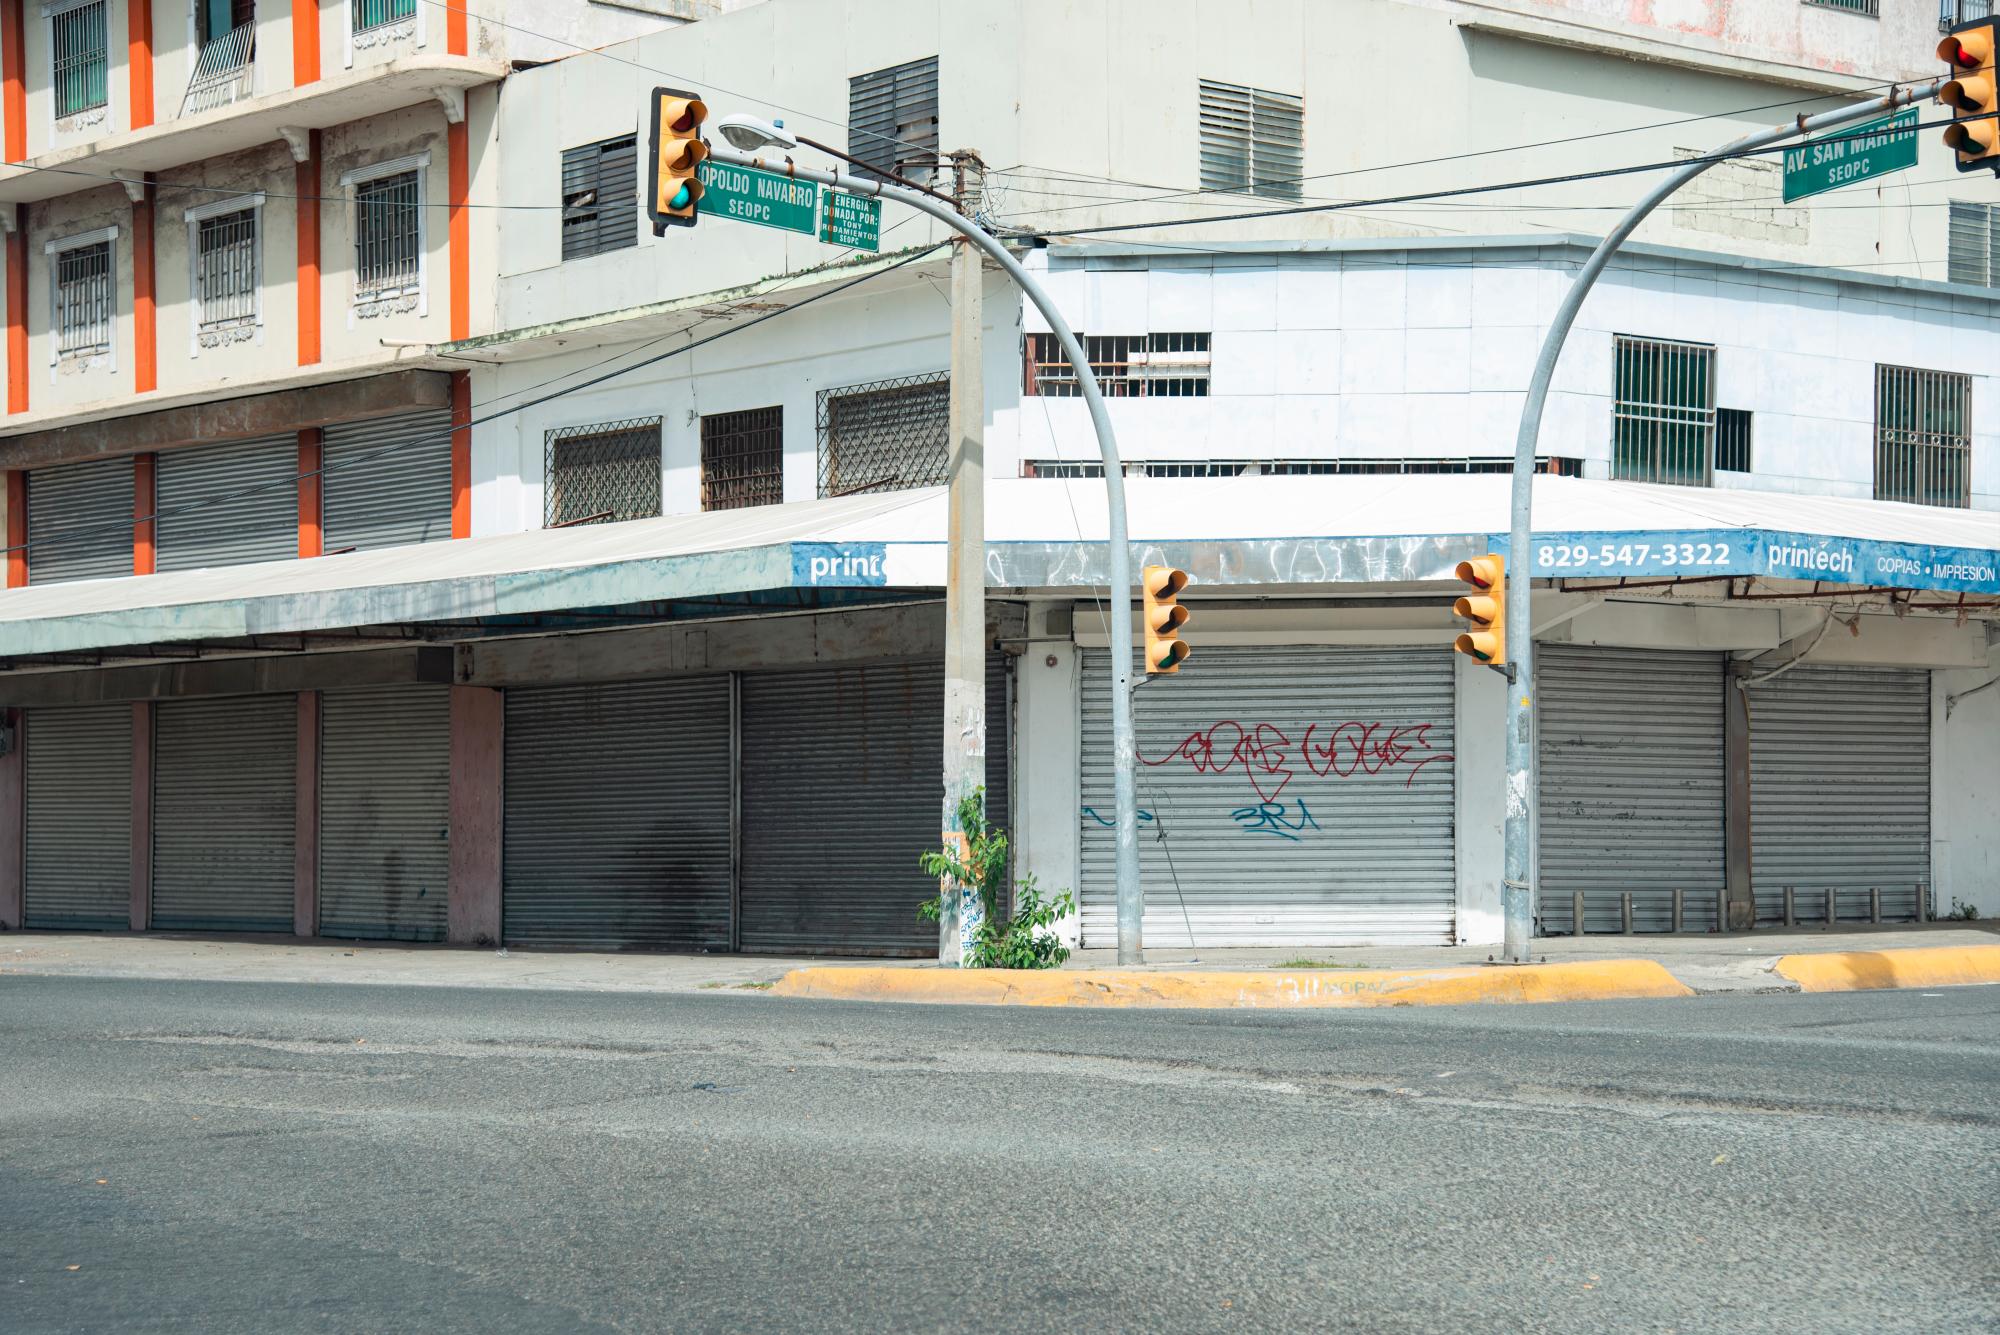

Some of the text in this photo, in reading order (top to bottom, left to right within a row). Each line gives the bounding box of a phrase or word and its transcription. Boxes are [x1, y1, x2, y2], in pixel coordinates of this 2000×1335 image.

[1786, 116, 1916, 175] AV. SAN MARTIN
[1828, 158, 1870, 184] SEOPC
[699, 165, 813, 208] OPOLDO NAVARRO
[728, 198, 771, 221] SEOPC
[835, 195, 869, 212] ENERGIA
[823, 205, 878, 226] DONADA POR:
[843, 219, 862, 230] TONY
[822, 223, 878, 241] RODAMIENTOS
[839, 234, 859, 246] SEOPC
[1538, 543, 1730, 567] 829-547-3322
[1877, 556, 1996, 582] COPIAS IMPRESION
